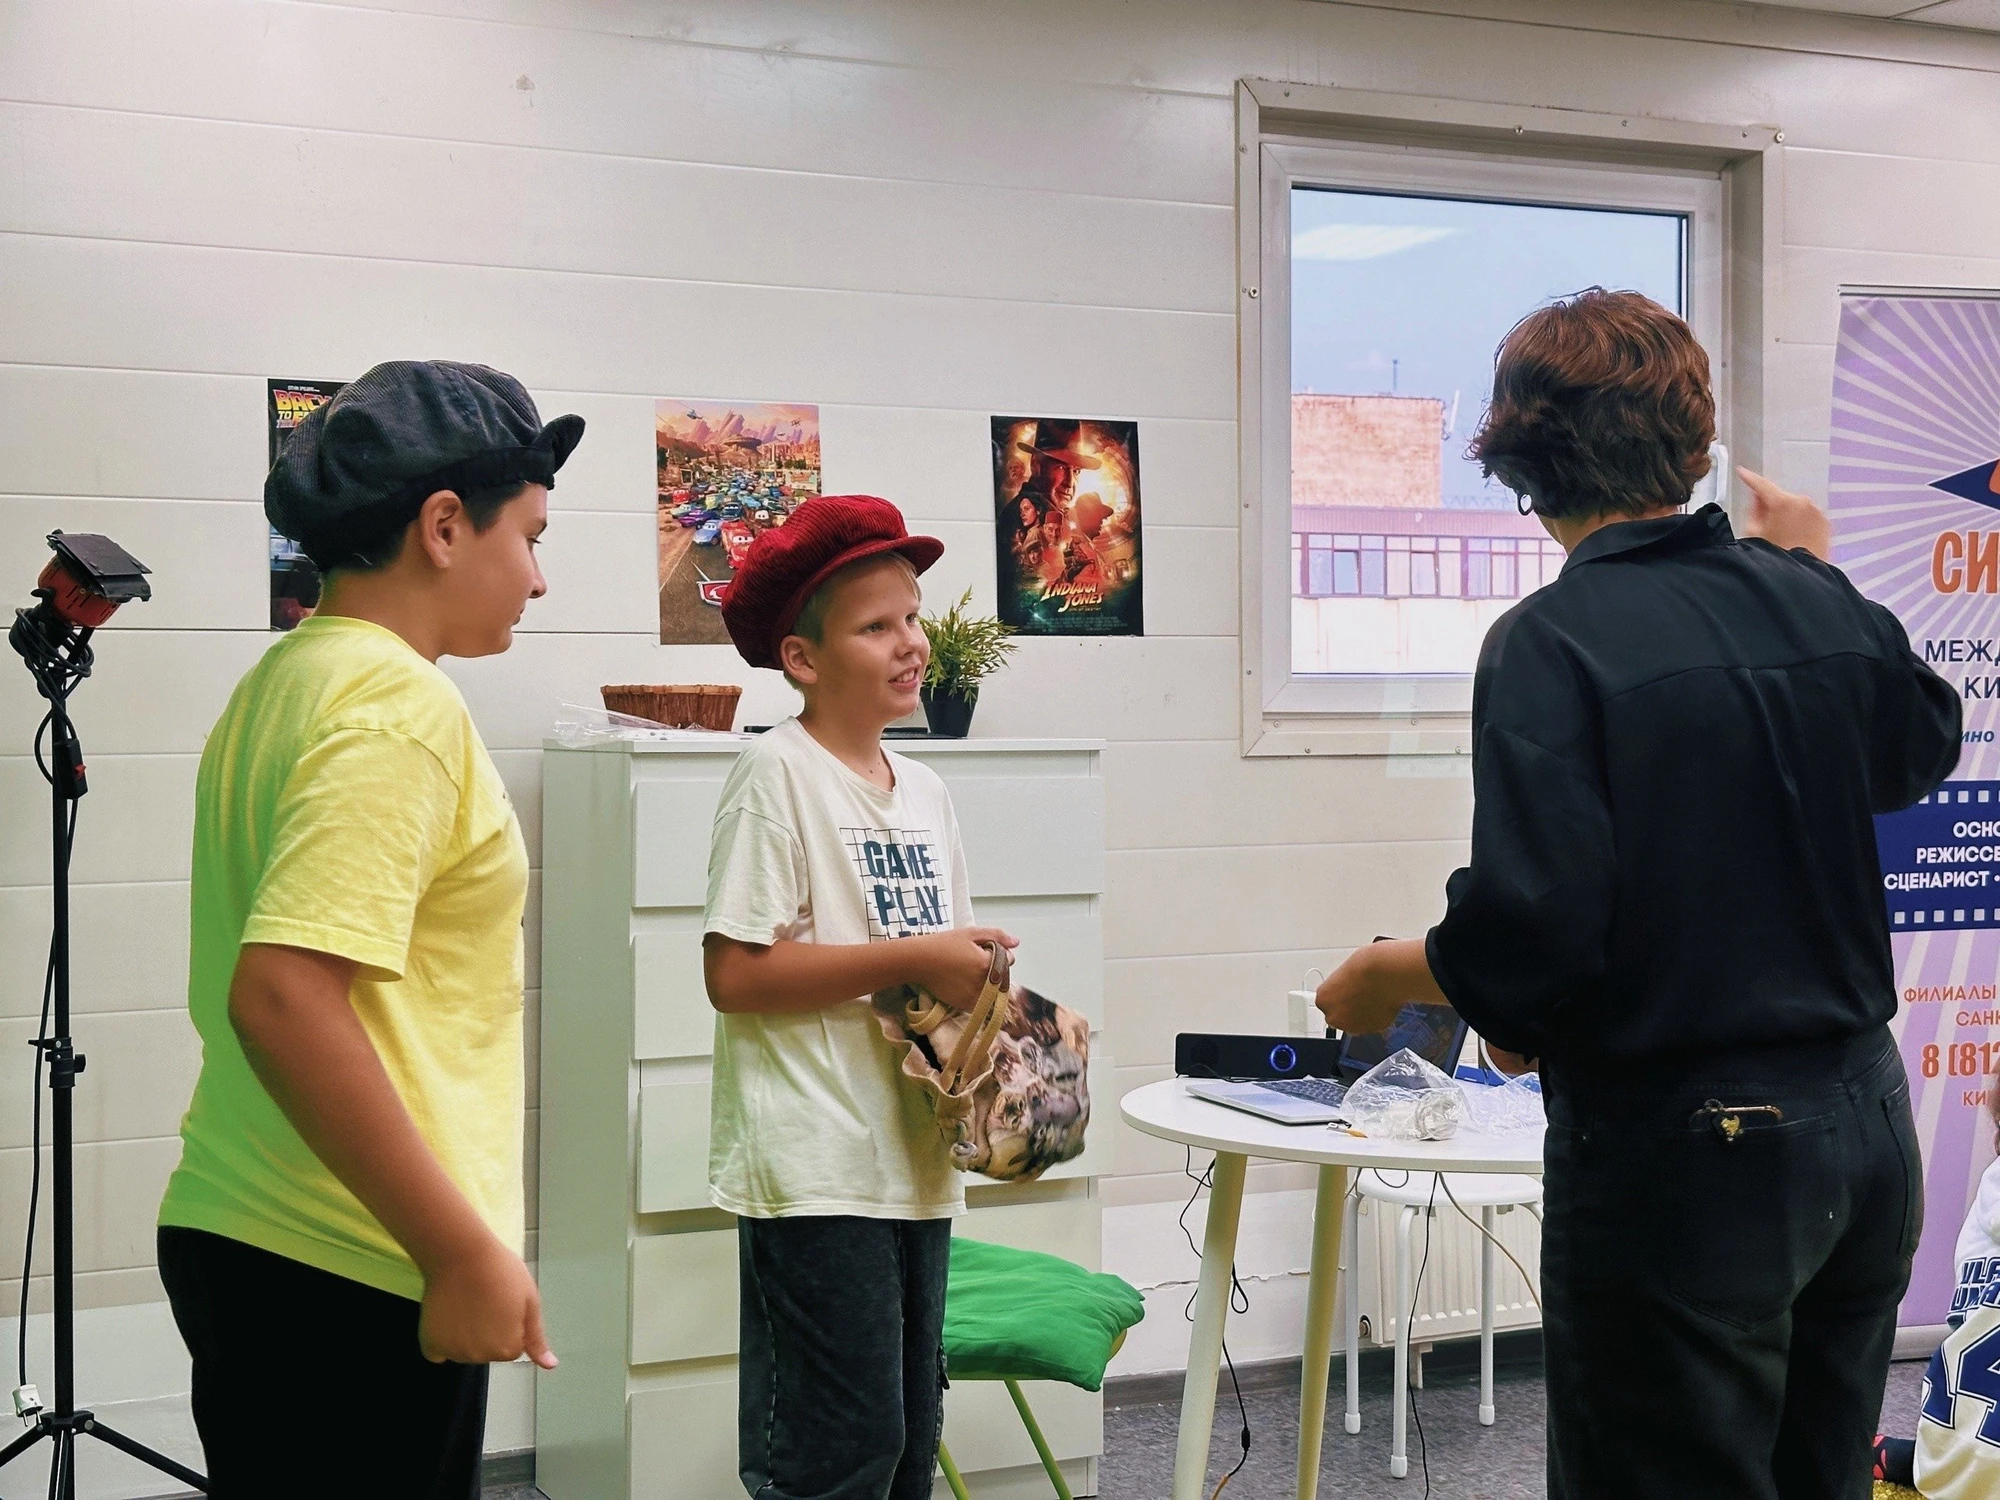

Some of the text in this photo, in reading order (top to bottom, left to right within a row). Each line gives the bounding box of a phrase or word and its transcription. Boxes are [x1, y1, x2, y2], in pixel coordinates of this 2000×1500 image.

[278, 410, 293, 420] TO
[1931, 530, 2000, 595] СИ
[1040, 582, 1098, 602] INDIANA
[1057, 593, 1104, 613] JONES
[1964, 676, 2000, 699] КИ
[863, 840, 935, 879] GAME
[1883, 870, 1990, 892] СЦЕНАРИСТ
[874, 884, 943, 926] PLAY
[1904, 984, 1997, 1003] ФИЛИАЛЫ
[1921, 1044, 1940, 1078] 8
